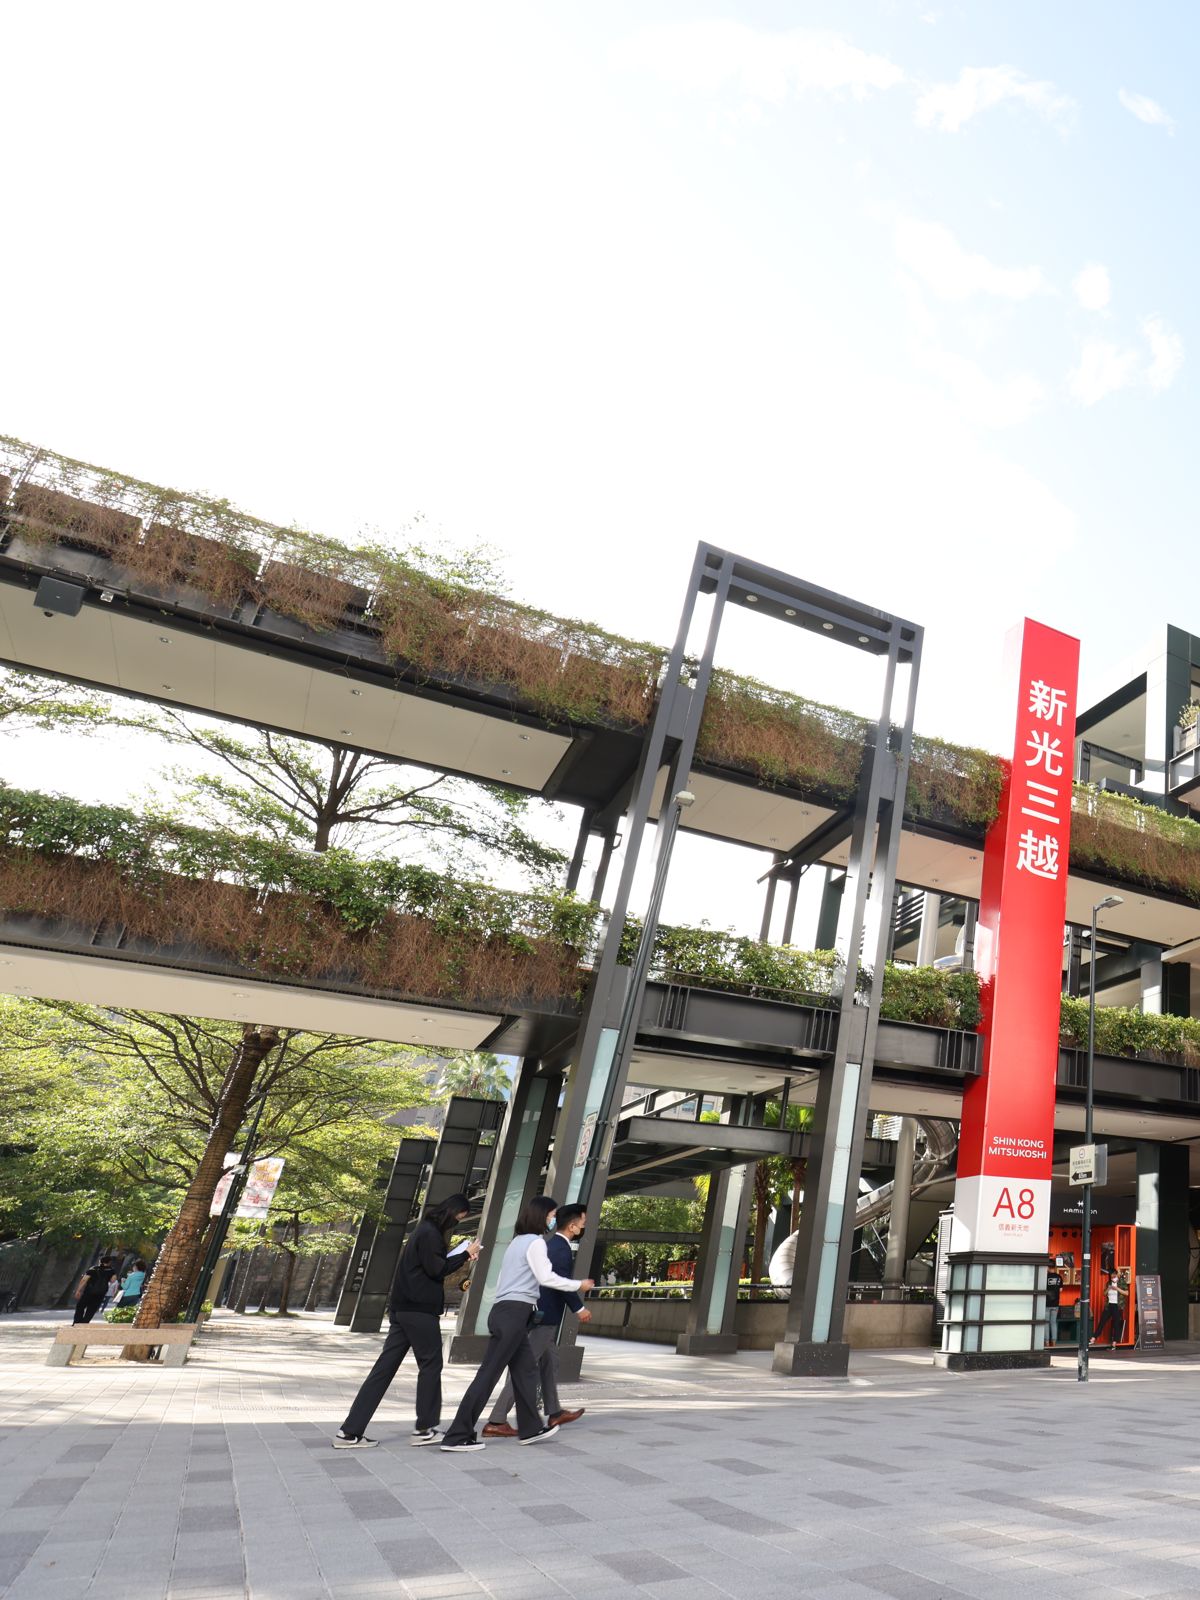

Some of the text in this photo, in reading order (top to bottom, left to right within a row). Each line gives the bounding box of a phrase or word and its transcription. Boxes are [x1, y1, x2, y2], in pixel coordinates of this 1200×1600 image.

[1016, 679, 1068, 881] 新光三越
[993, 1136, 1044, 1149] SHIN KONG
[988, 1146, 1047, 1159] MITSUKOSHI
[992, 1187, 1035, 1220] A8
[1063, 1207, 1098, 1215] HAMILON
